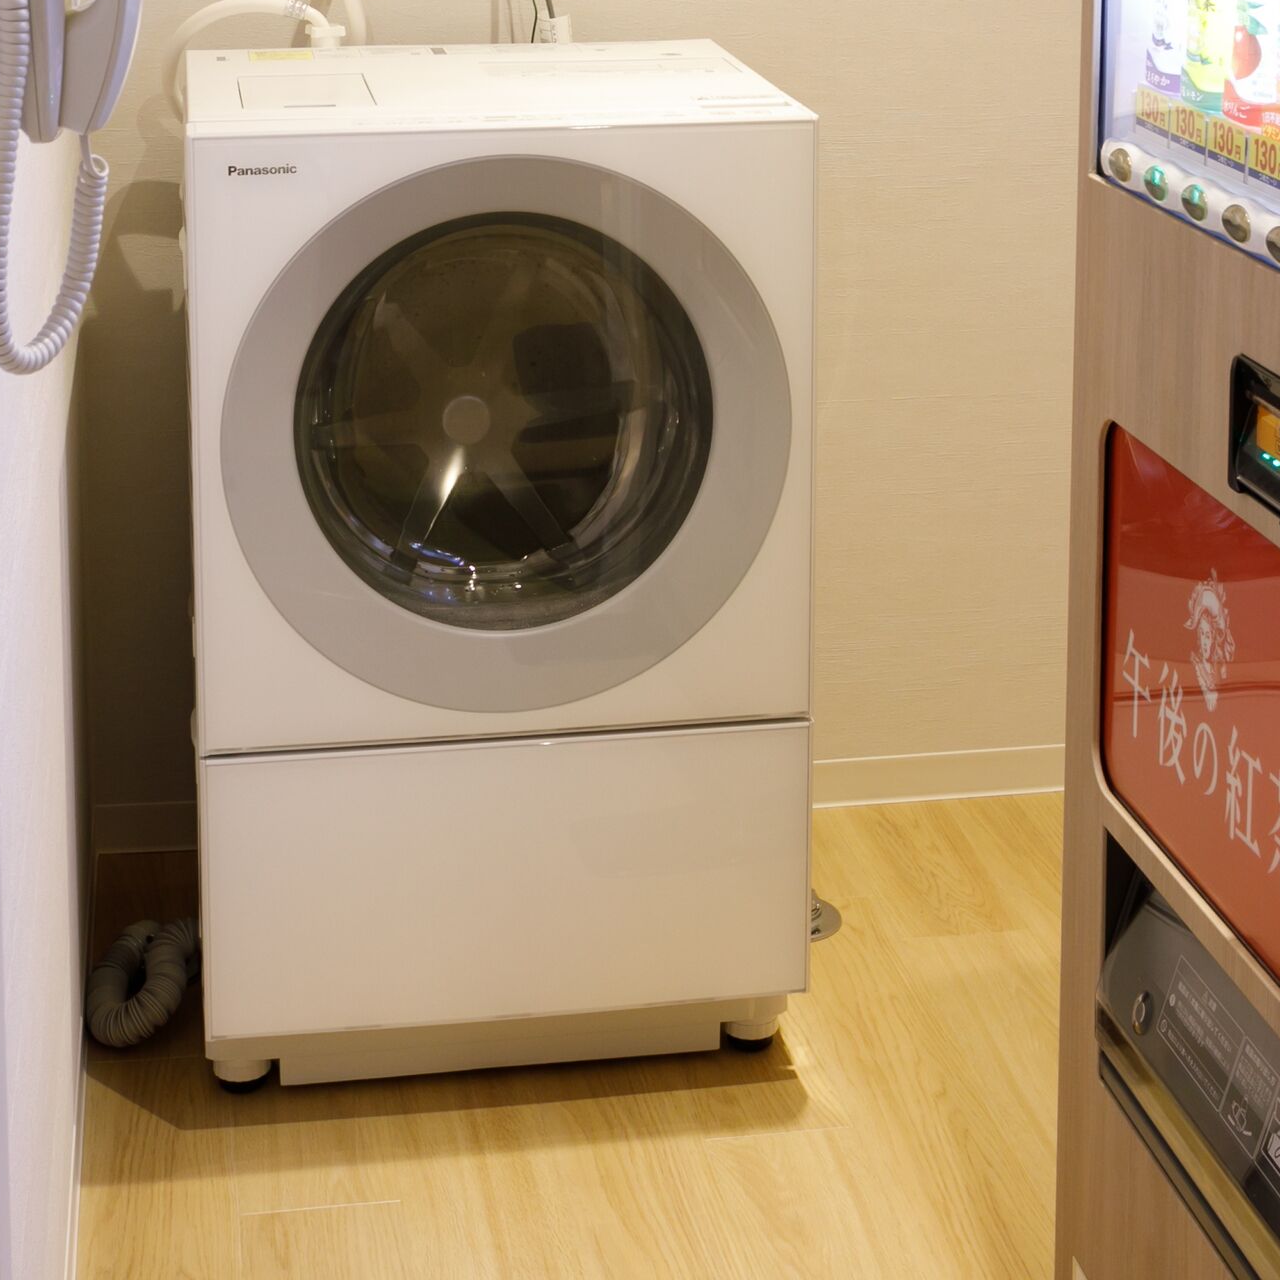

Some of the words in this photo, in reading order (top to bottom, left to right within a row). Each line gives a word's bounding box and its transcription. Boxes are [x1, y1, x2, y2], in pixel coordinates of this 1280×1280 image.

[1141, 91, 1165, 126] 130円
[1176, 106, 1201, 141] 130円
[1213, 121, 1241, 160] 130円
[228, 163, 297, 176] Panasonic
